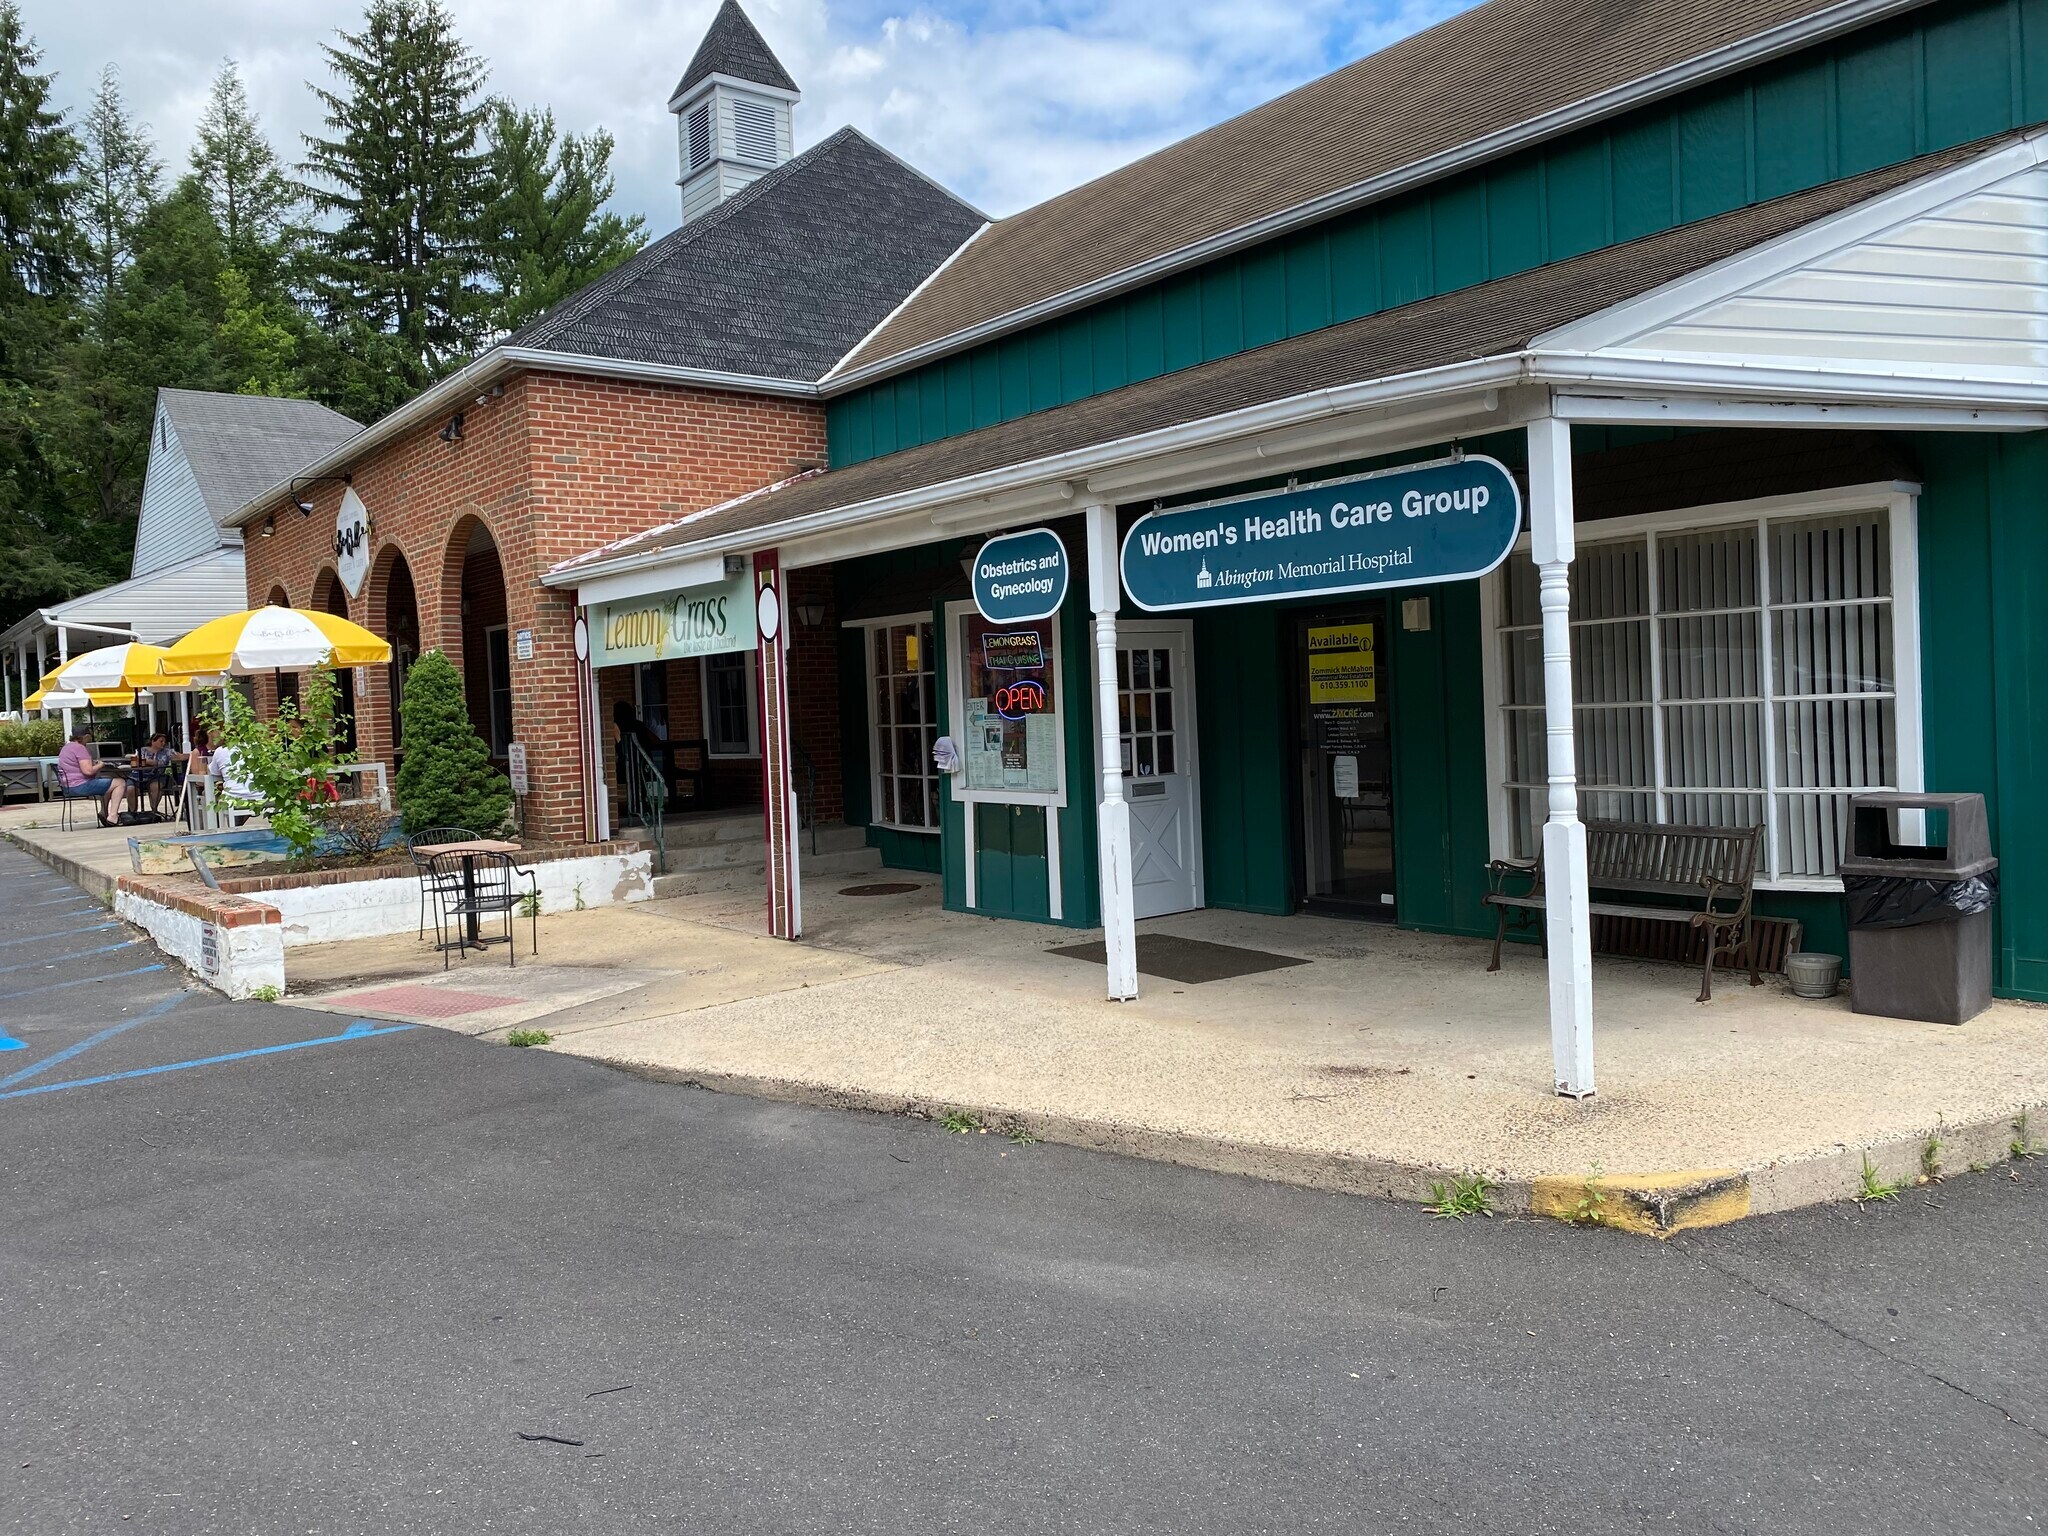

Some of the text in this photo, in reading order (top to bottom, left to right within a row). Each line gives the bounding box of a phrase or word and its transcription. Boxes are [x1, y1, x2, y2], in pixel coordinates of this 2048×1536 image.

[1140, 485, 1490, 556] Women's Health Care Group
[980, 552, 1059, 579] Obstetrics and
[1214, 546, 1413, 589] Abington Memorial Hospital
[990, 576, 1054, 599] Gynecology
[605, 594, 727, 651] Lemon Grass
[1309, 633, 1359, 648] Available
[1007, 654, 1041, 665] CUISINE
[1311, 665, 1374, 675] Zommick McMahon
[1319, 680, 1369, 690] 610.359.1100
[967, 700, 985, 712] ENTER
[995, 688, 1043, 711] OPEN
[1313, 708, 1374, 719] www.ZMCRE.com
